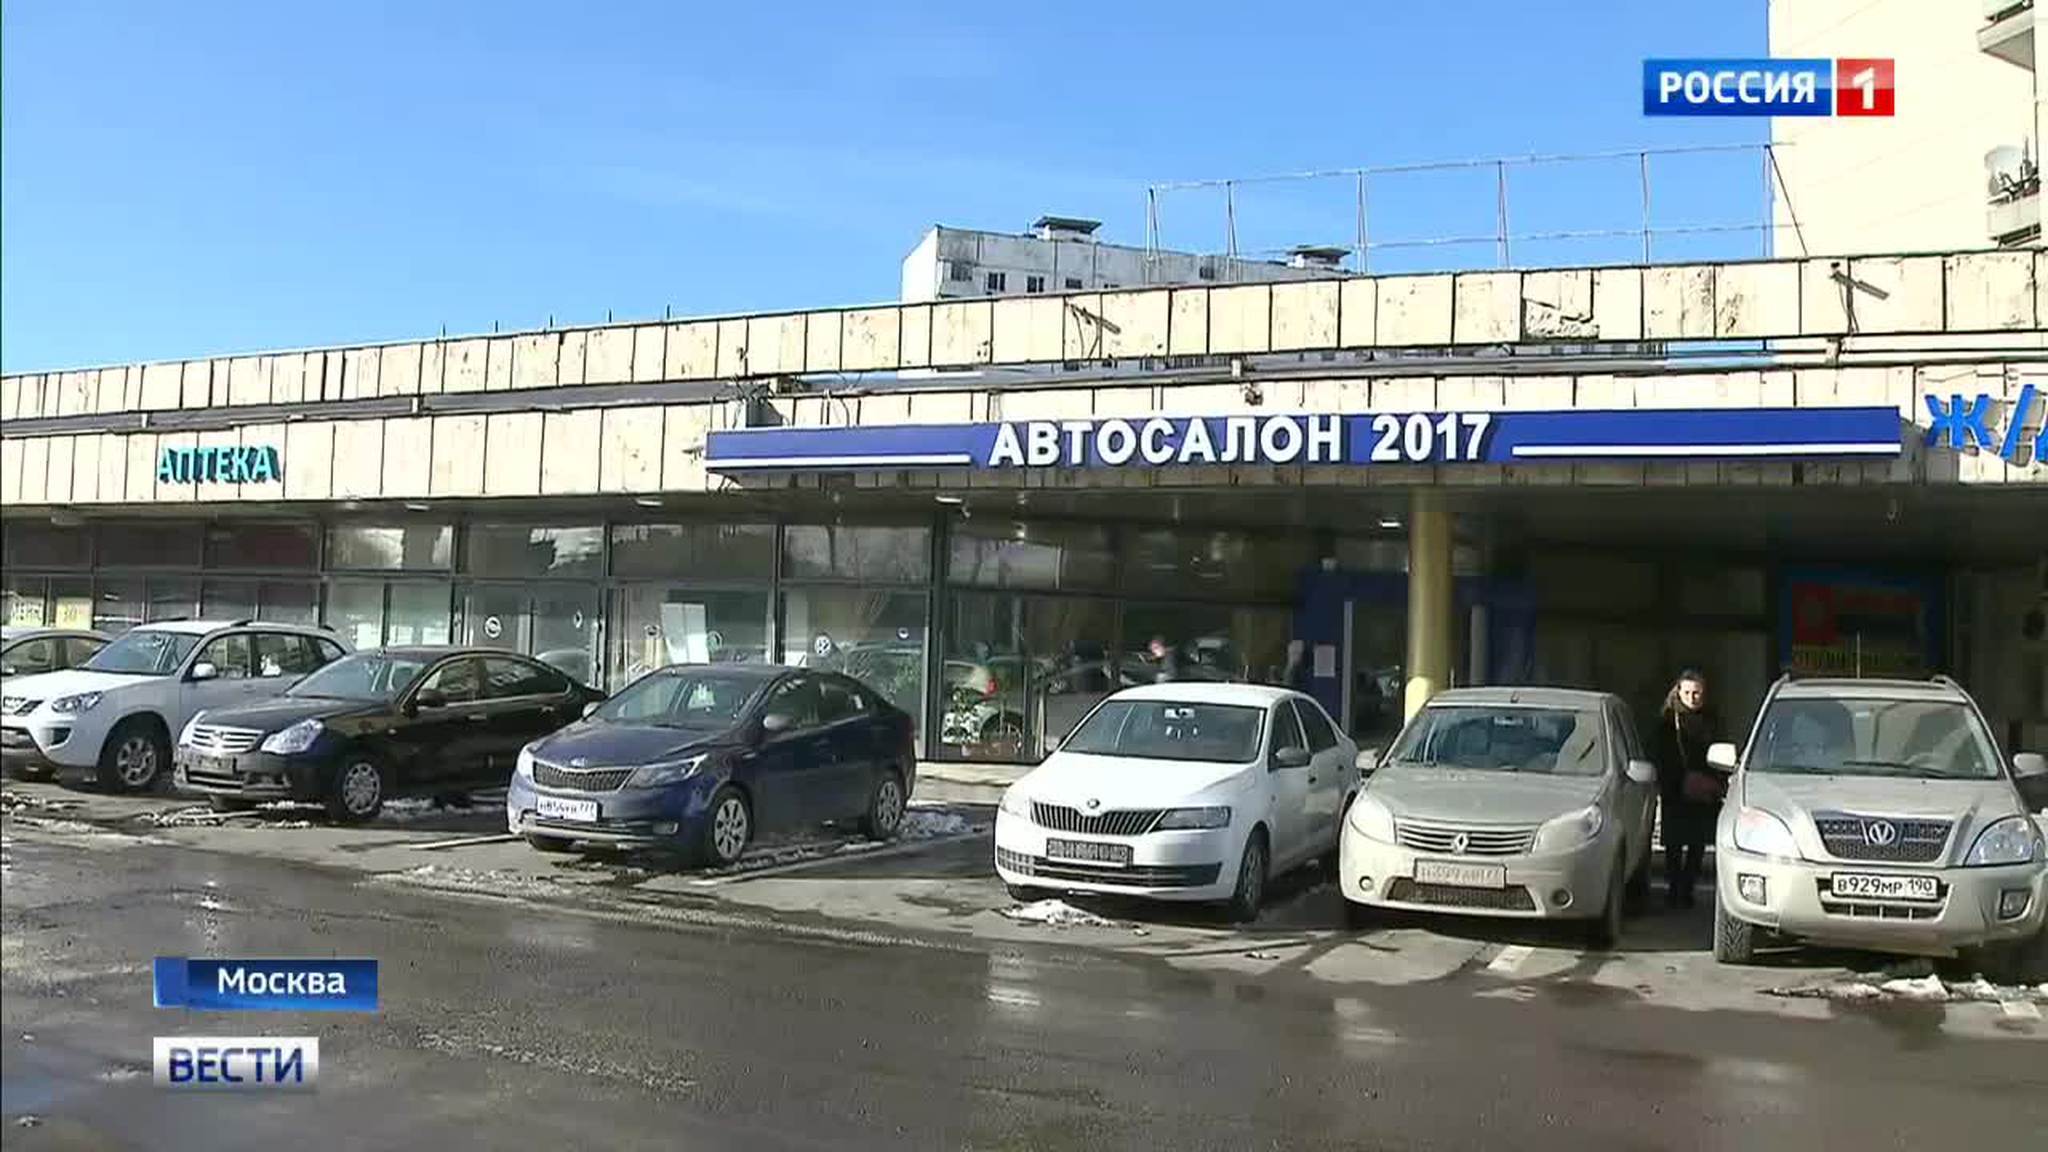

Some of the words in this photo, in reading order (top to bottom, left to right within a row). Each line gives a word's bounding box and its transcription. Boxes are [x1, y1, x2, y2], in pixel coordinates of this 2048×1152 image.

[988, 413, 1342, 467] АВТОСАЛОН
[1370, 412, 1491, 462] 2017
[1924, 384, 2048, 461] Ж/
[158, 446, 281, 483] АПТЕКА
[1838, 876, 1903, 894] В929МР
